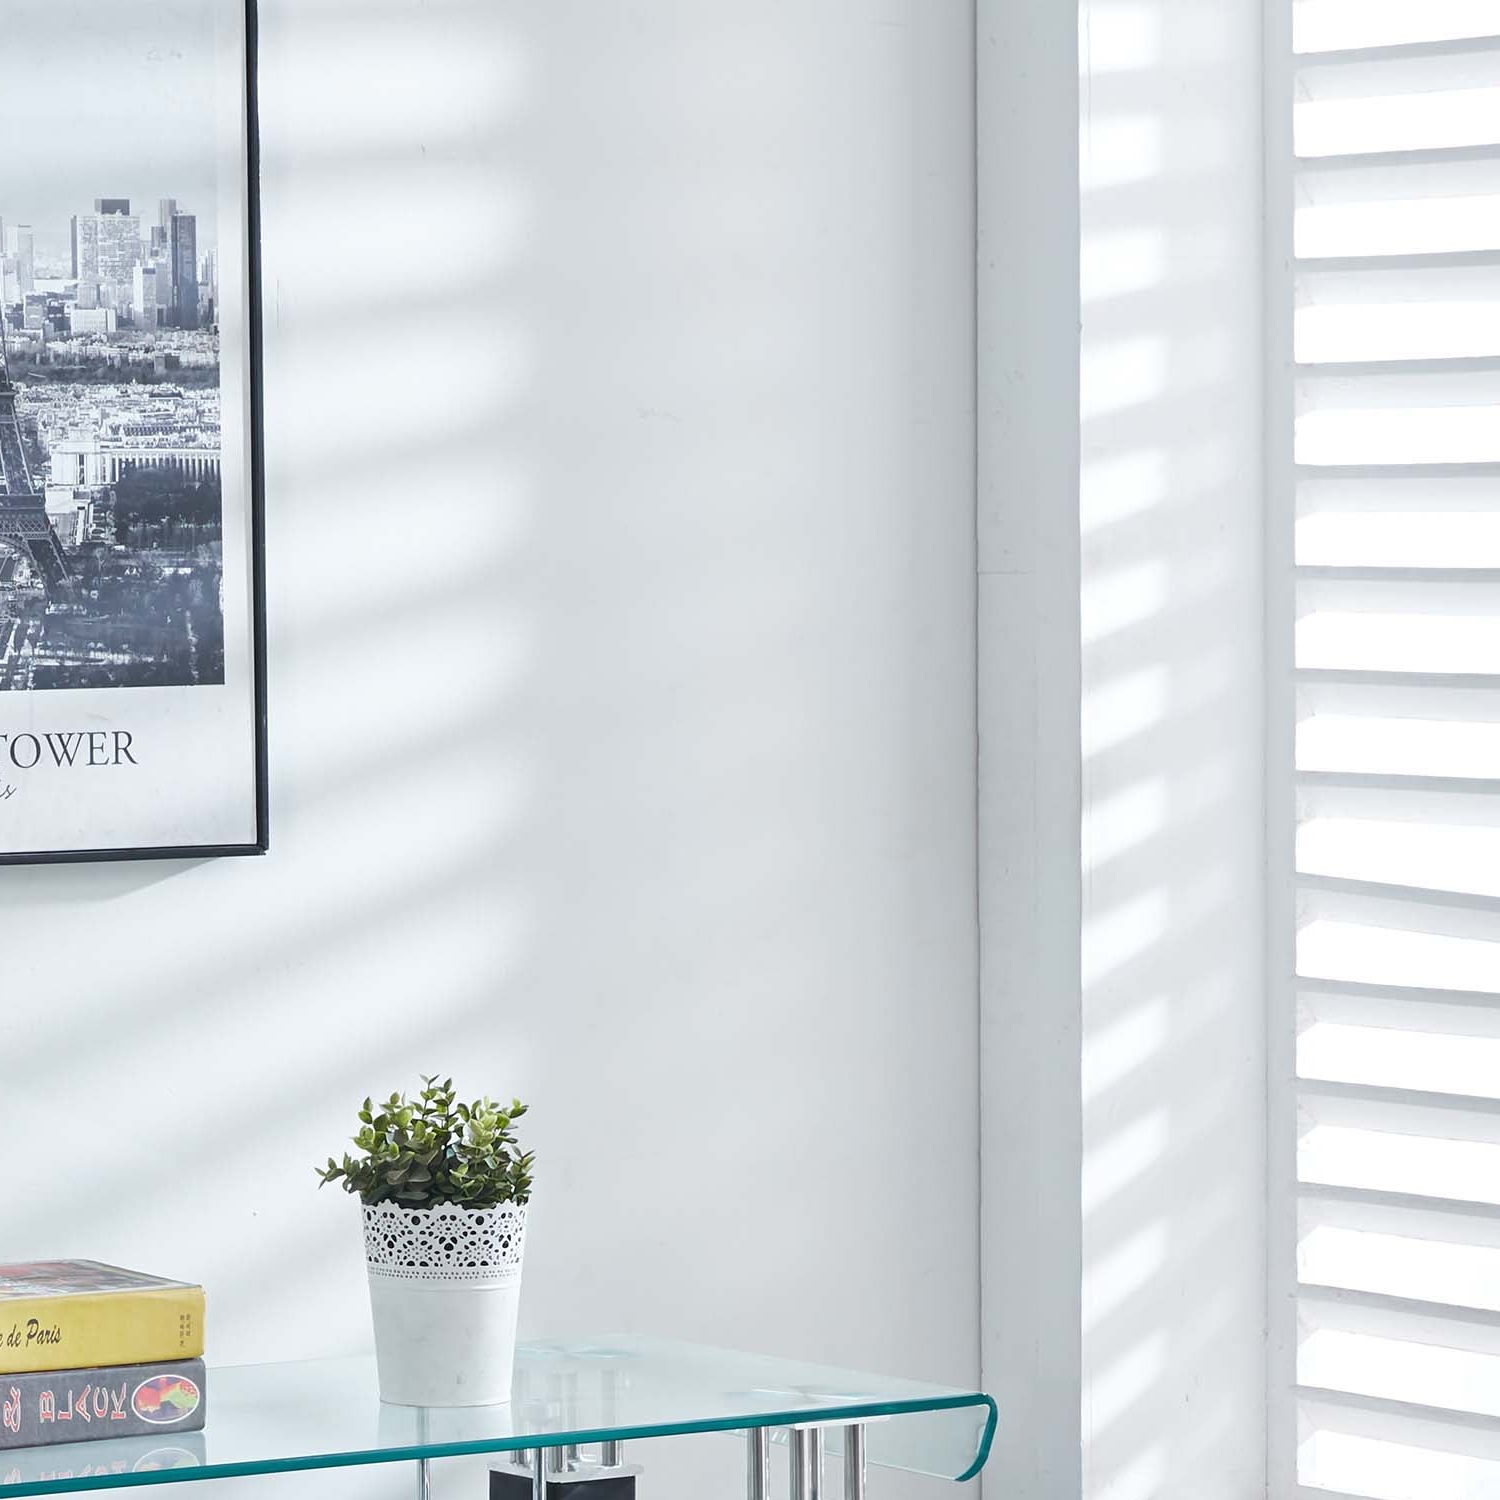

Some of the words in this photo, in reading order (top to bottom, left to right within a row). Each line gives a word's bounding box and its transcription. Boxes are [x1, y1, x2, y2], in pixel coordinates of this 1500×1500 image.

[6, 1323, 22, 1348] de
[25, 1318, 62, 1348] Paris
[3, 1385, 21, 1433] &
[39, 1382, 128, 1424] BLACK
